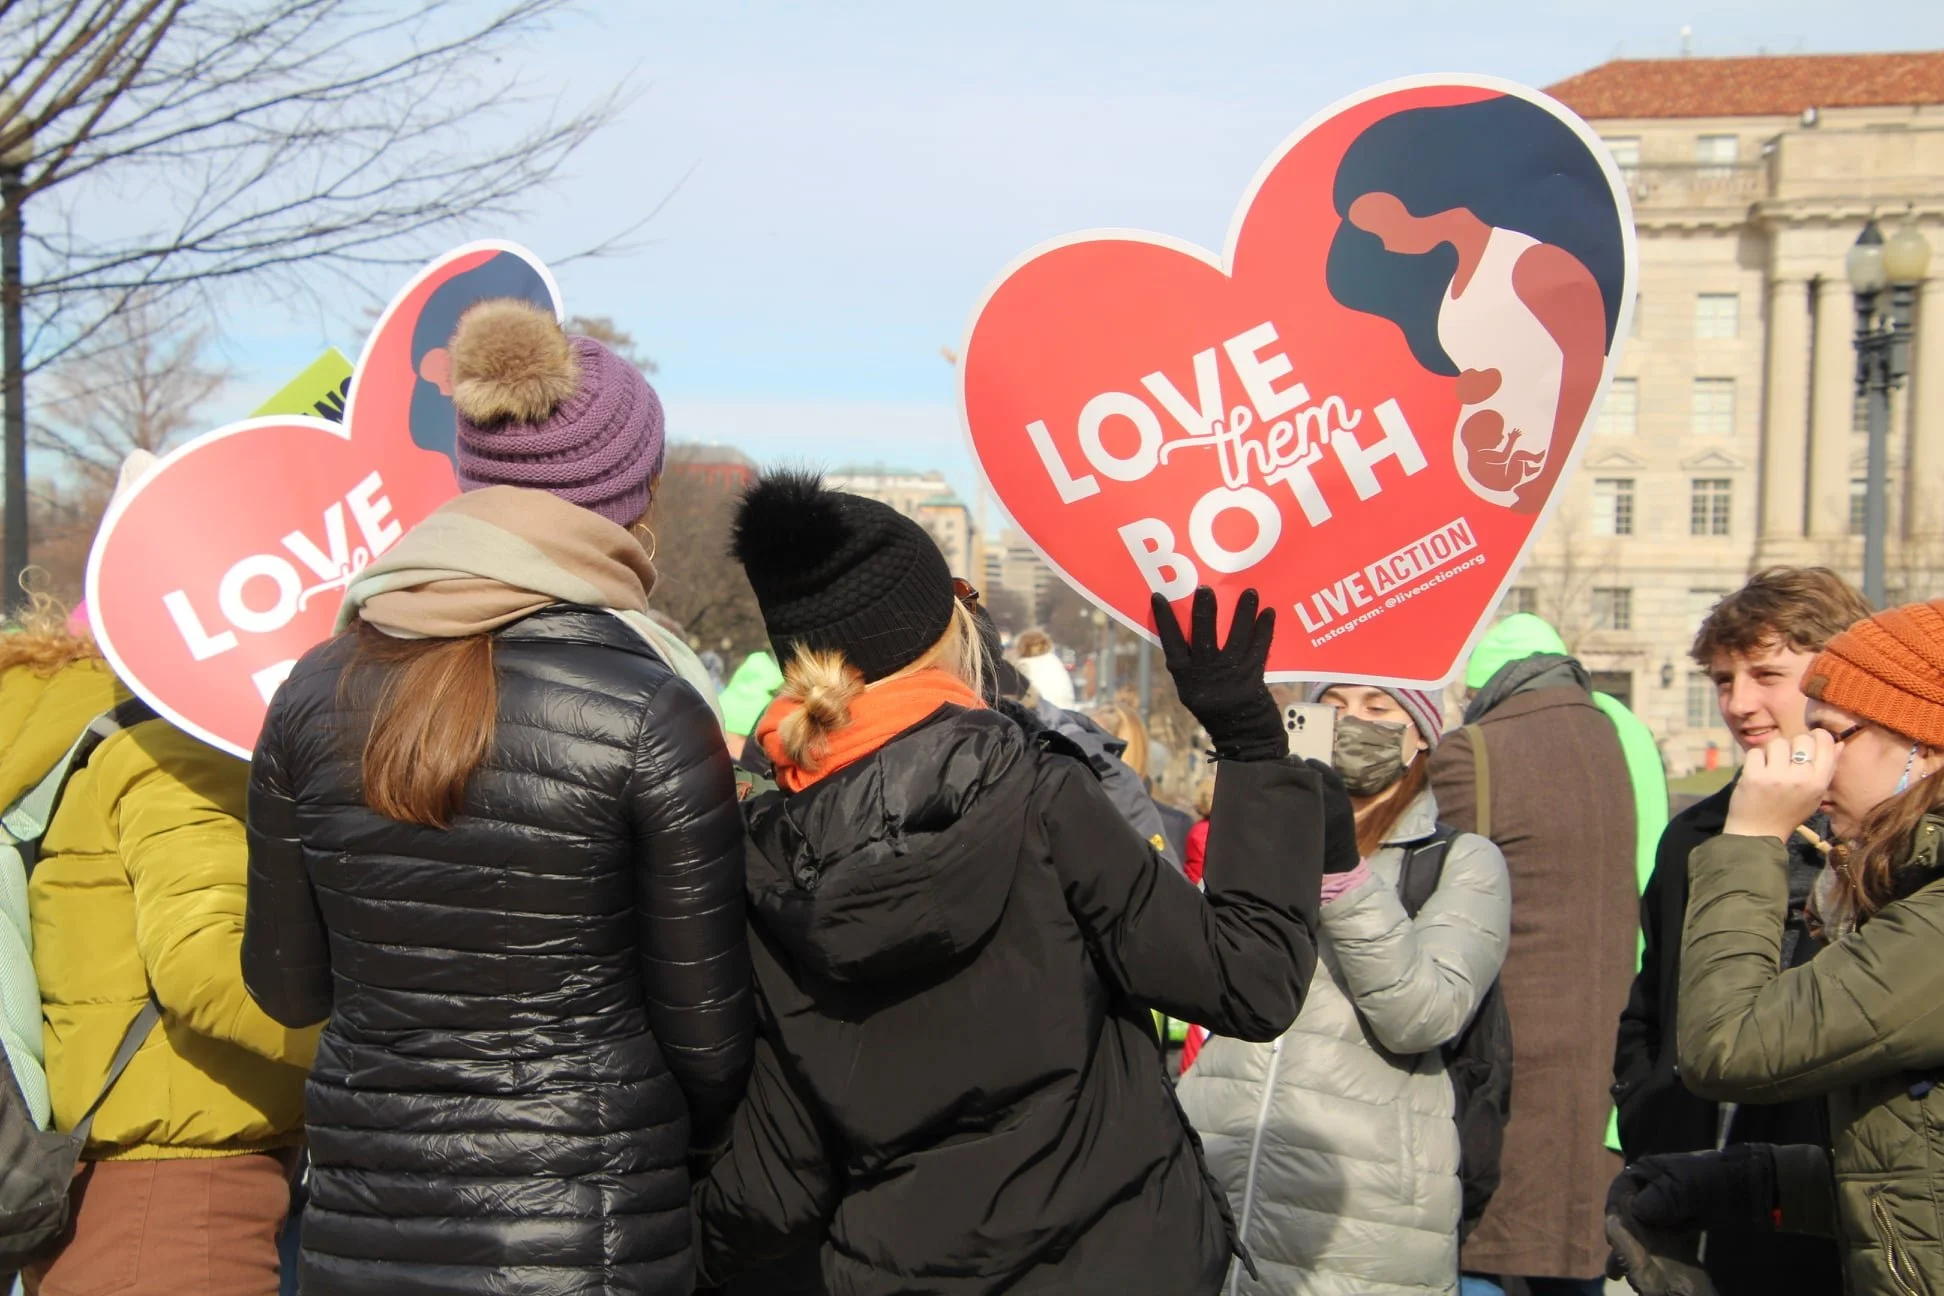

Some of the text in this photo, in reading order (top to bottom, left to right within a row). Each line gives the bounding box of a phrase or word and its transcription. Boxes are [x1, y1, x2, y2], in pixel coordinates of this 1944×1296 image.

[1026, 321, 1310, 504] LOVE
[1159, 395, 1362, 489] them
[162, 469, 403, 661] LOVE
[1117, 397, 1428, 603] BOTH
[1293, 521, 1473, 634] LIVE ACTION
[1311, 553, 1486, 648] Instagram: @liveactionorg
